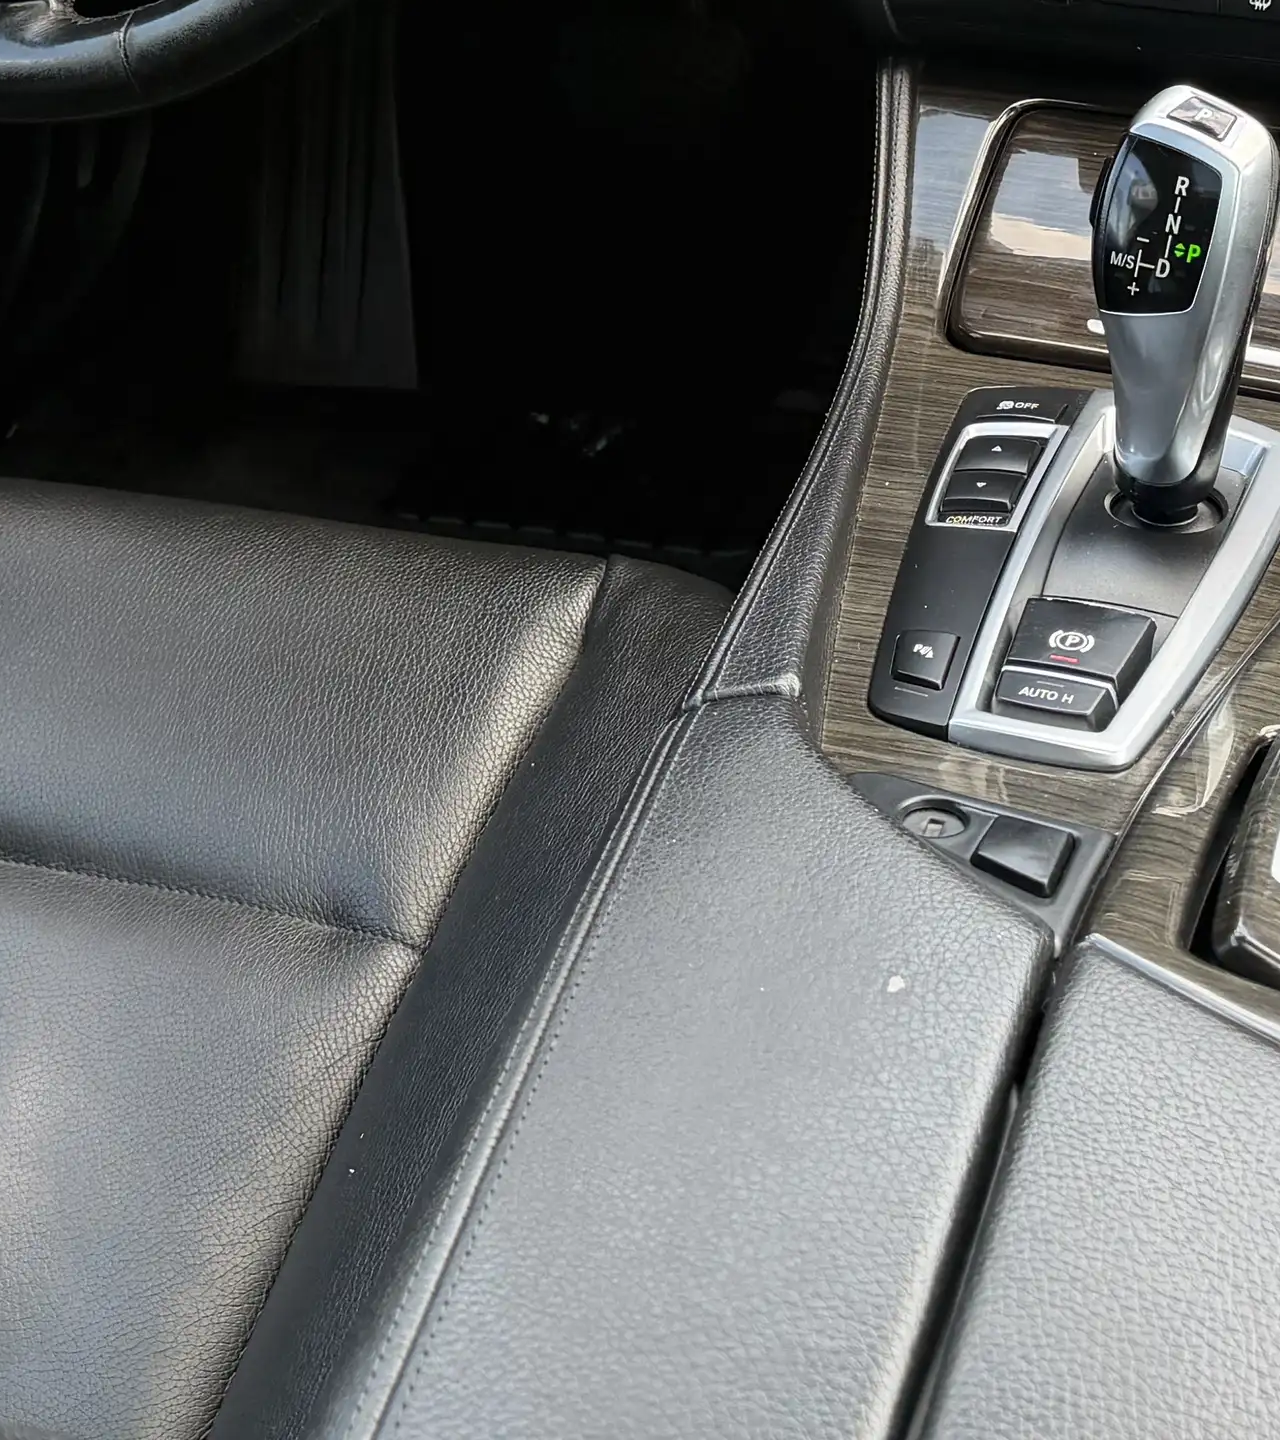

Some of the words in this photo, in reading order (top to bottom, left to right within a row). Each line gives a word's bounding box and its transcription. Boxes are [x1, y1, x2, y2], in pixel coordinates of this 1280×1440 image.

[1194, 108, 1214, 122] P
[1174, 175, 1190, 197] R
[1165, 213, 1182, 235] N
[1109, 250, 1136, 270] M/S
[1186, 244, 1202, 264] P
[1155, 258, 1171, 279] D
[1014, 401, 1040, 410] OFF
[945, 515, 1002, 525] COMFORT
[1019, 686, 1058, 702] AUTO
[1061, 693, 1075, 704] H
